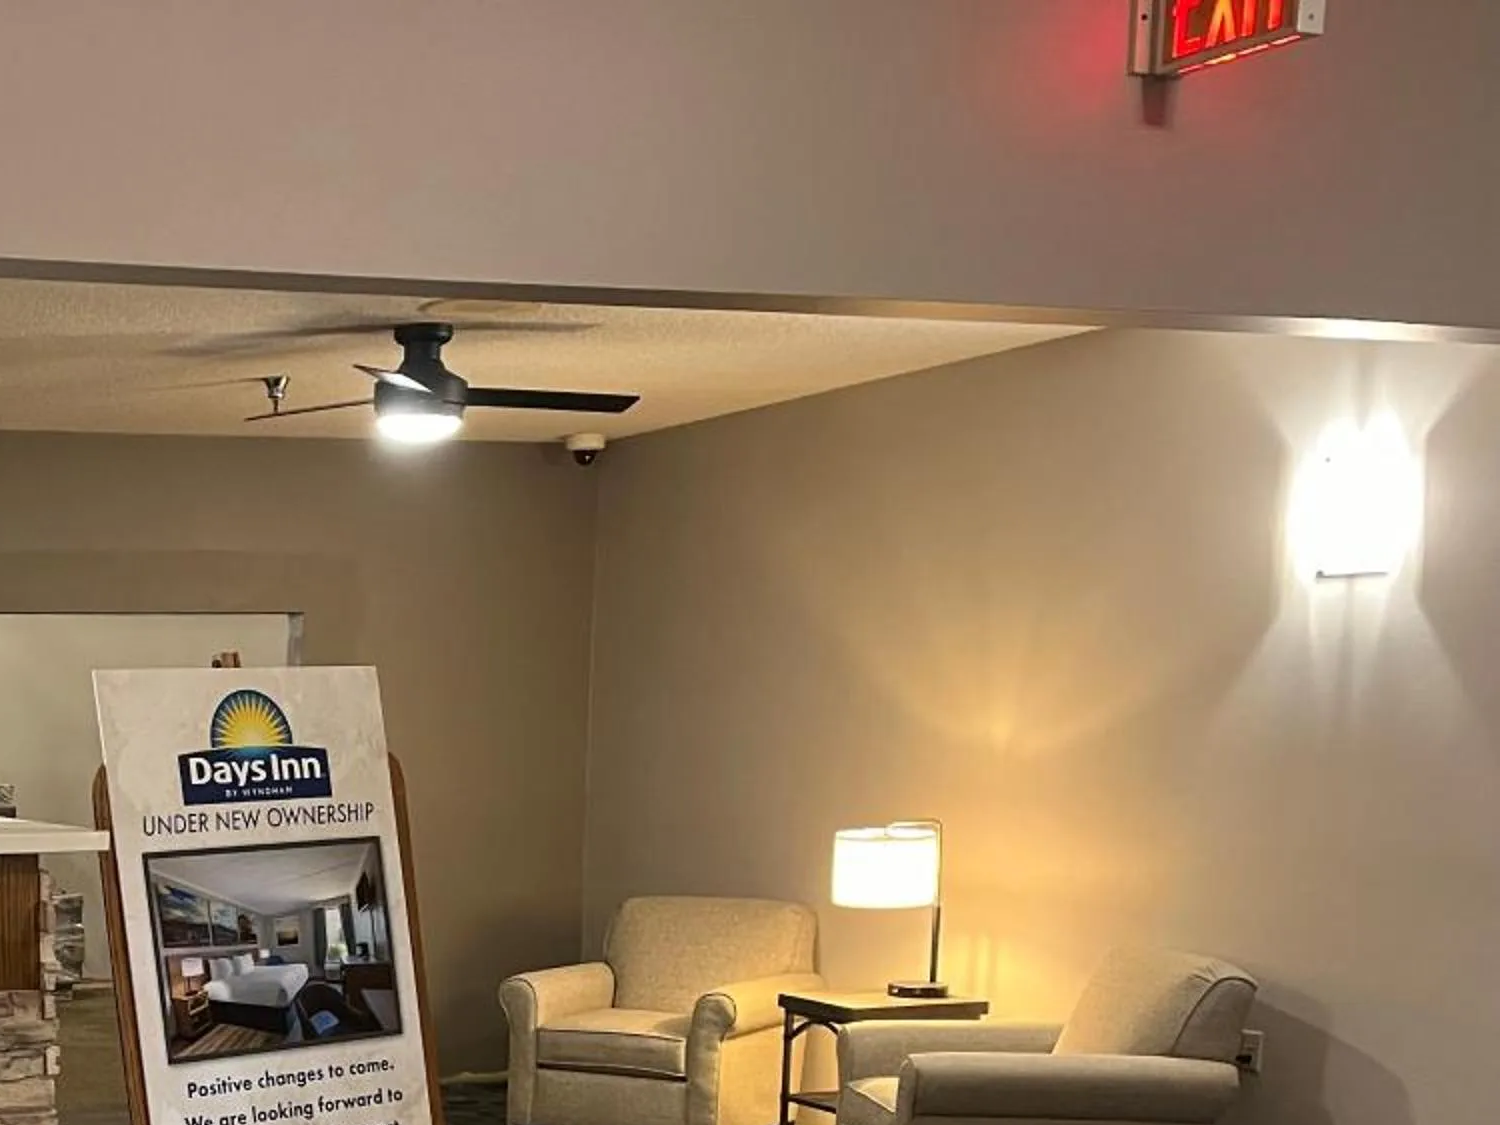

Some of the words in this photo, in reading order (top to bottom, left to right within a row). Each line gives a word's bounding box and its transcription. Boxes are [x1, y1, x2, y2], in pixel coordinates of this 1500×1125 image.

[188, 754, 266, 787] Days
[271, 754, 322, 781] Inn
[143, 813, 209, 837] UNDER
[215, 809, 262, 832] NEW
[267, 802, 375, 827] OWNERSHIP
[187, 1076, 253, 1099] Positive
[257, 1068, 324, 1090] changes
[328, 1063, 345, 1079] to
[349, 1057, 395, 1075] come.
[251, 1101, 314, 1124] looking
[318, 1088, 384, 1113] forward
[388, 1086, 403, 1102] to
